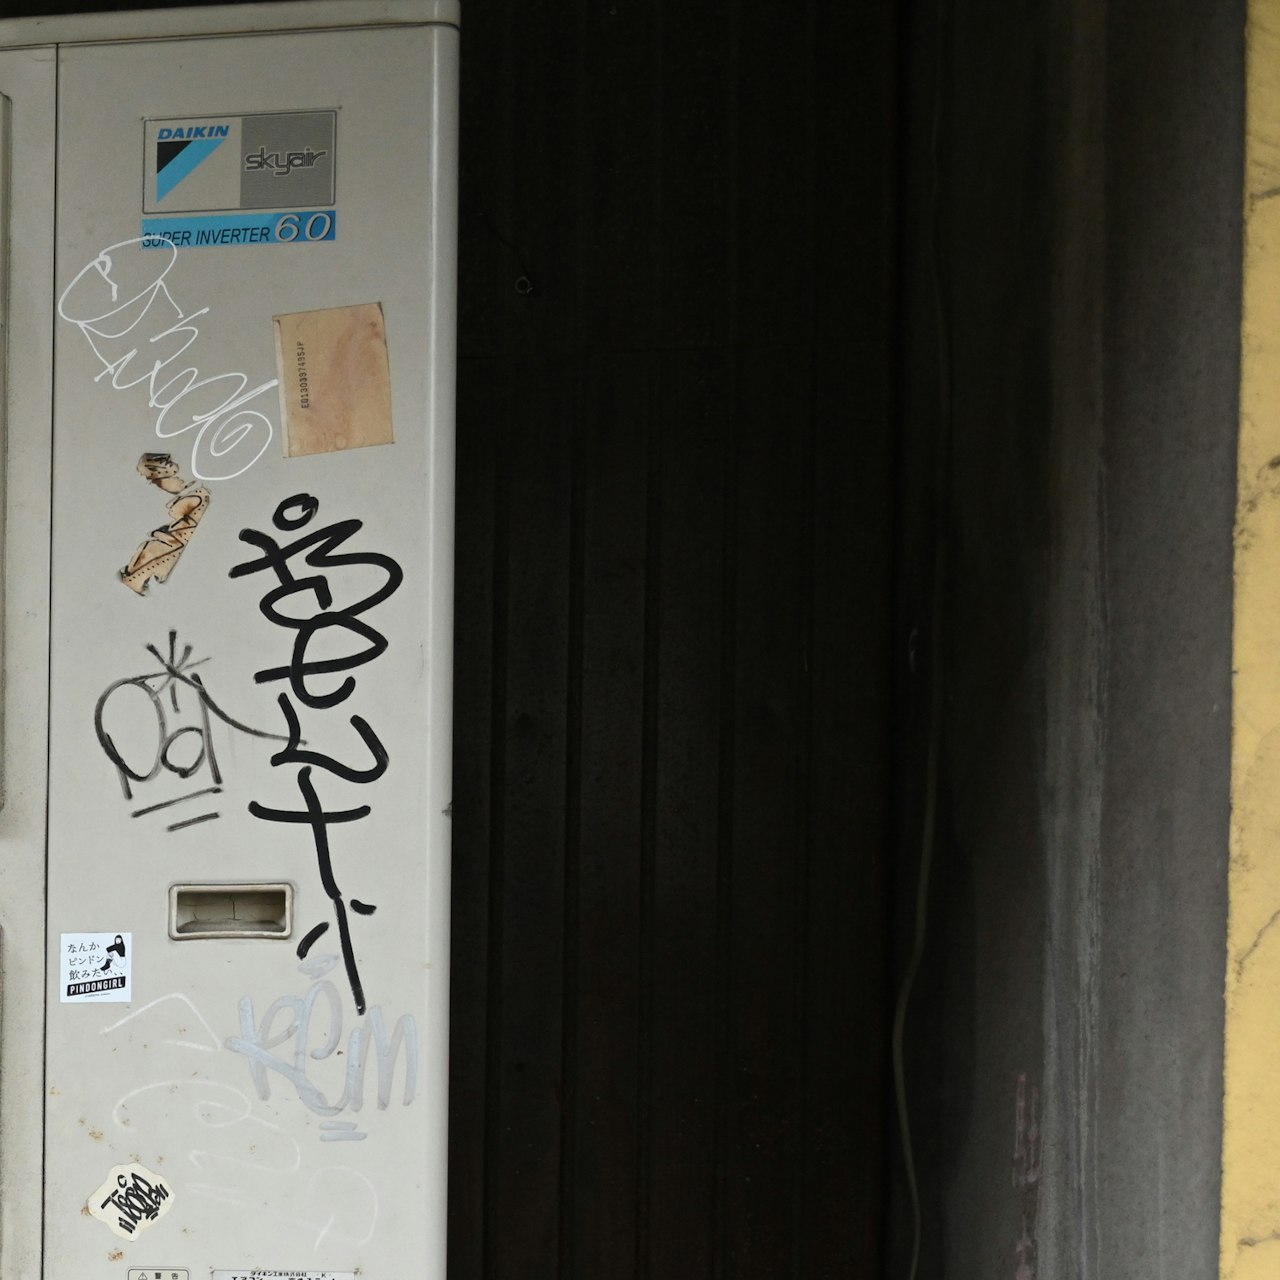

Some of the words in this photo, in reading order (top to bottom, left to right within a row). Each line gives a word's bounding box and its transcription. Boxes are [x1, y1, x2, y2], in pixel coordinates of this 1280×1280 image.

[158, 125, 230, 140] DAIKIN
[244, 146, 327, 177] skyair
[142, 231, 192, 247] SUPER
[195, 227, 270, 245] INVERTER
[274, 212, 332, 243] 60
[67, 942, 100, 953] なんか
[69, 979, 123, 994] PINDONGIRL
